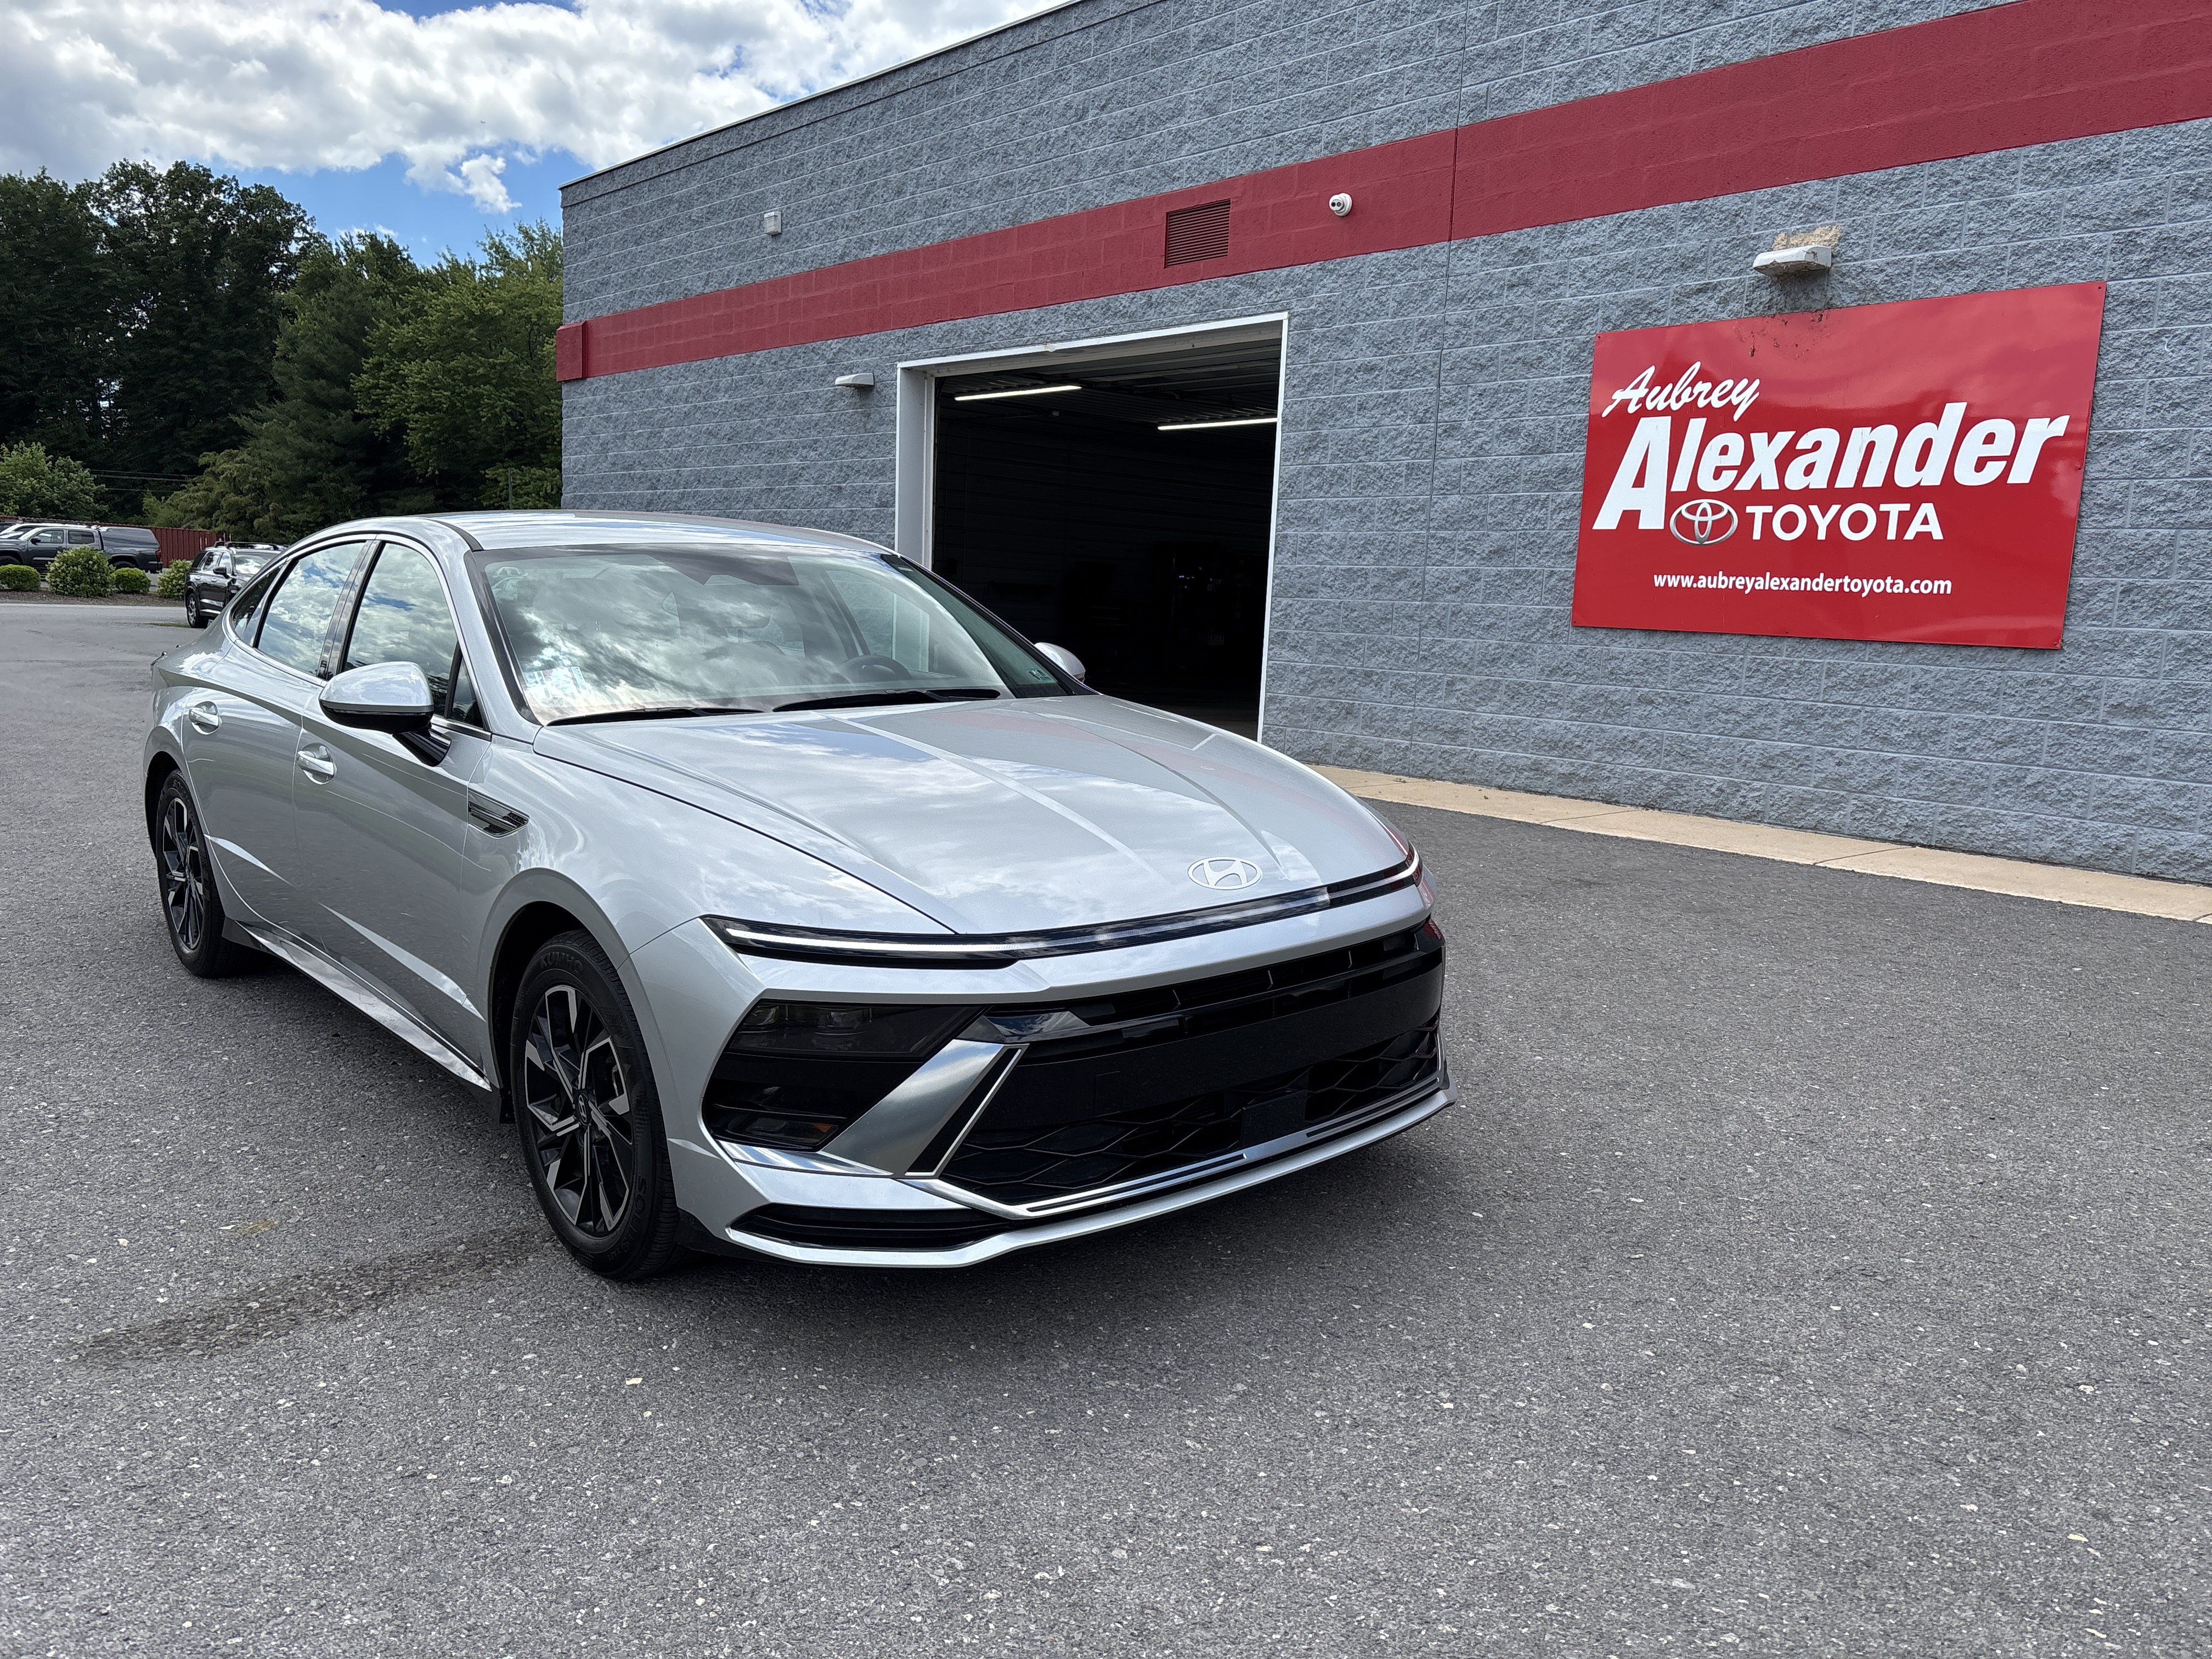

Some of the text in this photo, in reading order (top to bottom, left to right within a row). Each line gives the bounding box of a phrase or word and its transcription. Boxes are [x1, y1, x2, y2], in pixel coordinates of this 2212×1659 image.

[1602, 361, 1760, 421] Aubrey
[1593, 402, 2070, 530] Alexander
[1745, 503, 1944, 541] TOYOTA
[1654, 571, 1952, 598] www.aubreyalexandertoyota.com
[539, 951, 584, 975] KUMHO
